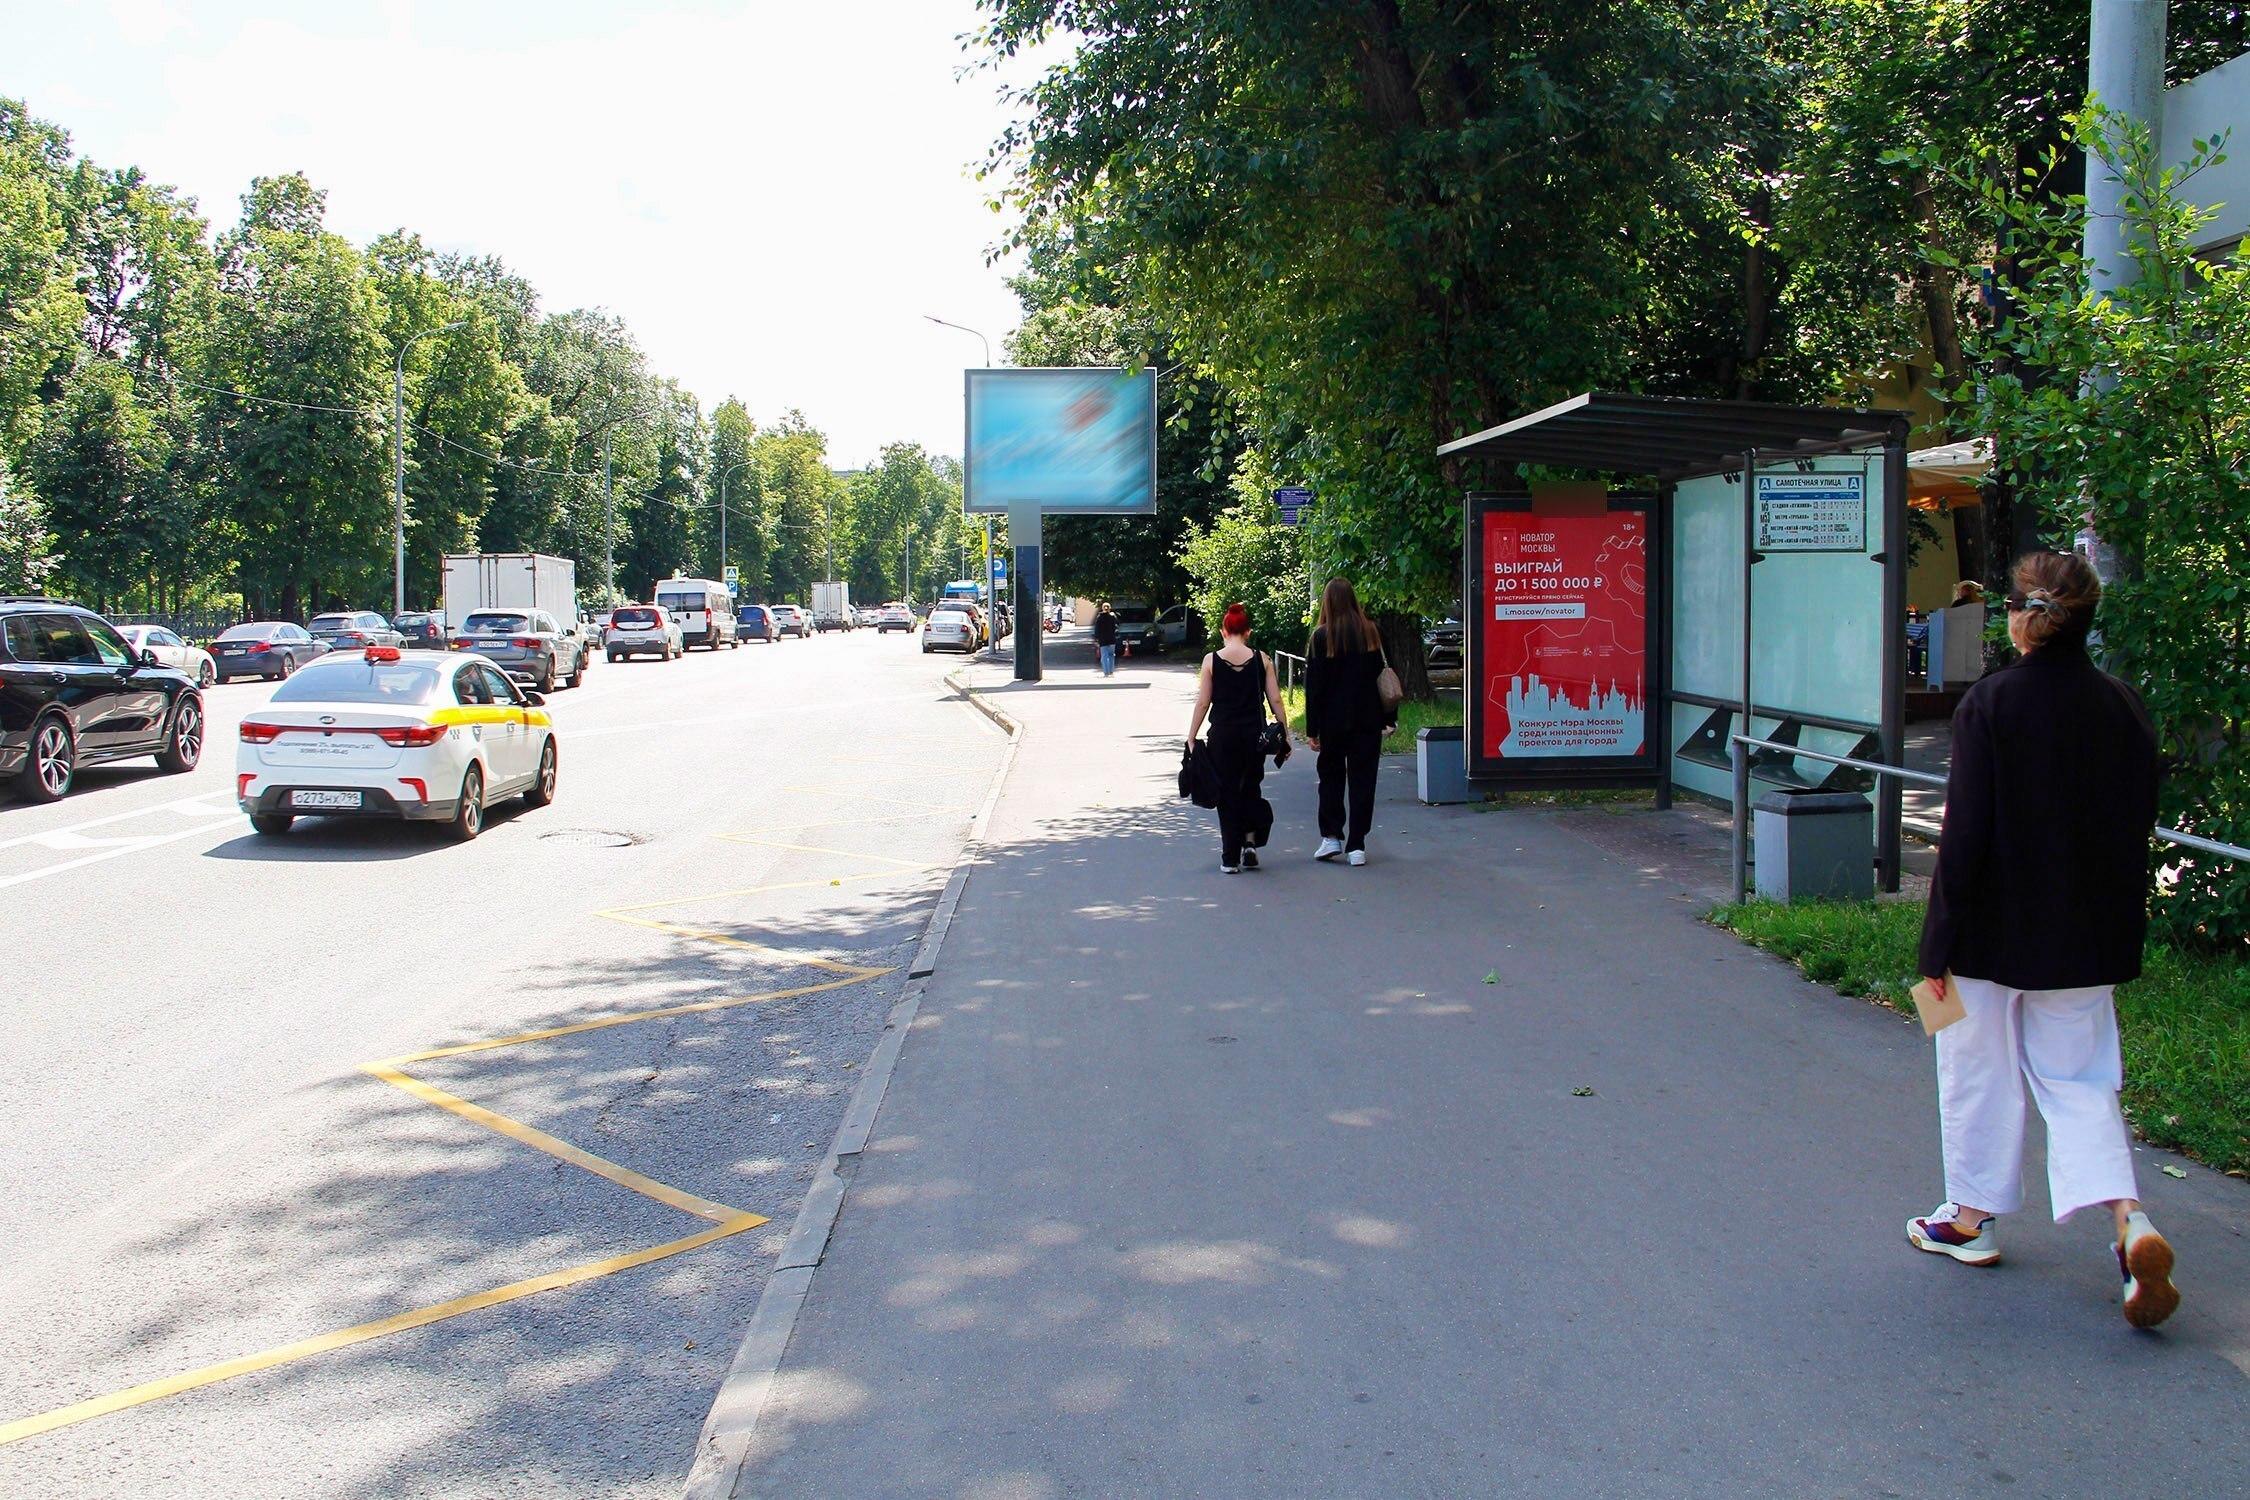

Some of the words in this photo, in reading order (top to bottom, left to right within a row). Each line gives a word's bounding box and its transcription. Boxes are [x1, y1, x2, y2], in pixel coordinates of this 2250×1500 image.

[1776, 479, 1819, 487] САМОТЁЧНАЯ
[1820, 479, 1841, 487] УЛИЦА
[1622, 523, 1636, 531] 18+
[1520, 533, 1556, 542] НОВАТОР
[1520, 544, 1556, 553] МОСКВЫ
[1494, 558, 1563, 574] ВЫИГРАЙ
[1495, 578, 1517, 592] ДО
[1520, 578, 1527, 589] 1
[1531, 578, 1558, 589] 500
[1562, 577, 1590, 589] 000
[1495, 593, 1540, 601] РЕГИСТРИРУЙСЯ
[1505, 607, 1576, 616] i.moscow/novator
[1518, 720, 1558, 729] Конкурс
[1560, 719, 1585, 728] Мэра
[1587, 718, 1624, 726] Москвы
[1518, 730, 1547, 738] среди
[1549, 728, 1624, 736] инновационных
[1518, 739, 1562, 748] проектов
[1564, 738, 1582, 746] для
[1585, 738, 1618, 746] города
